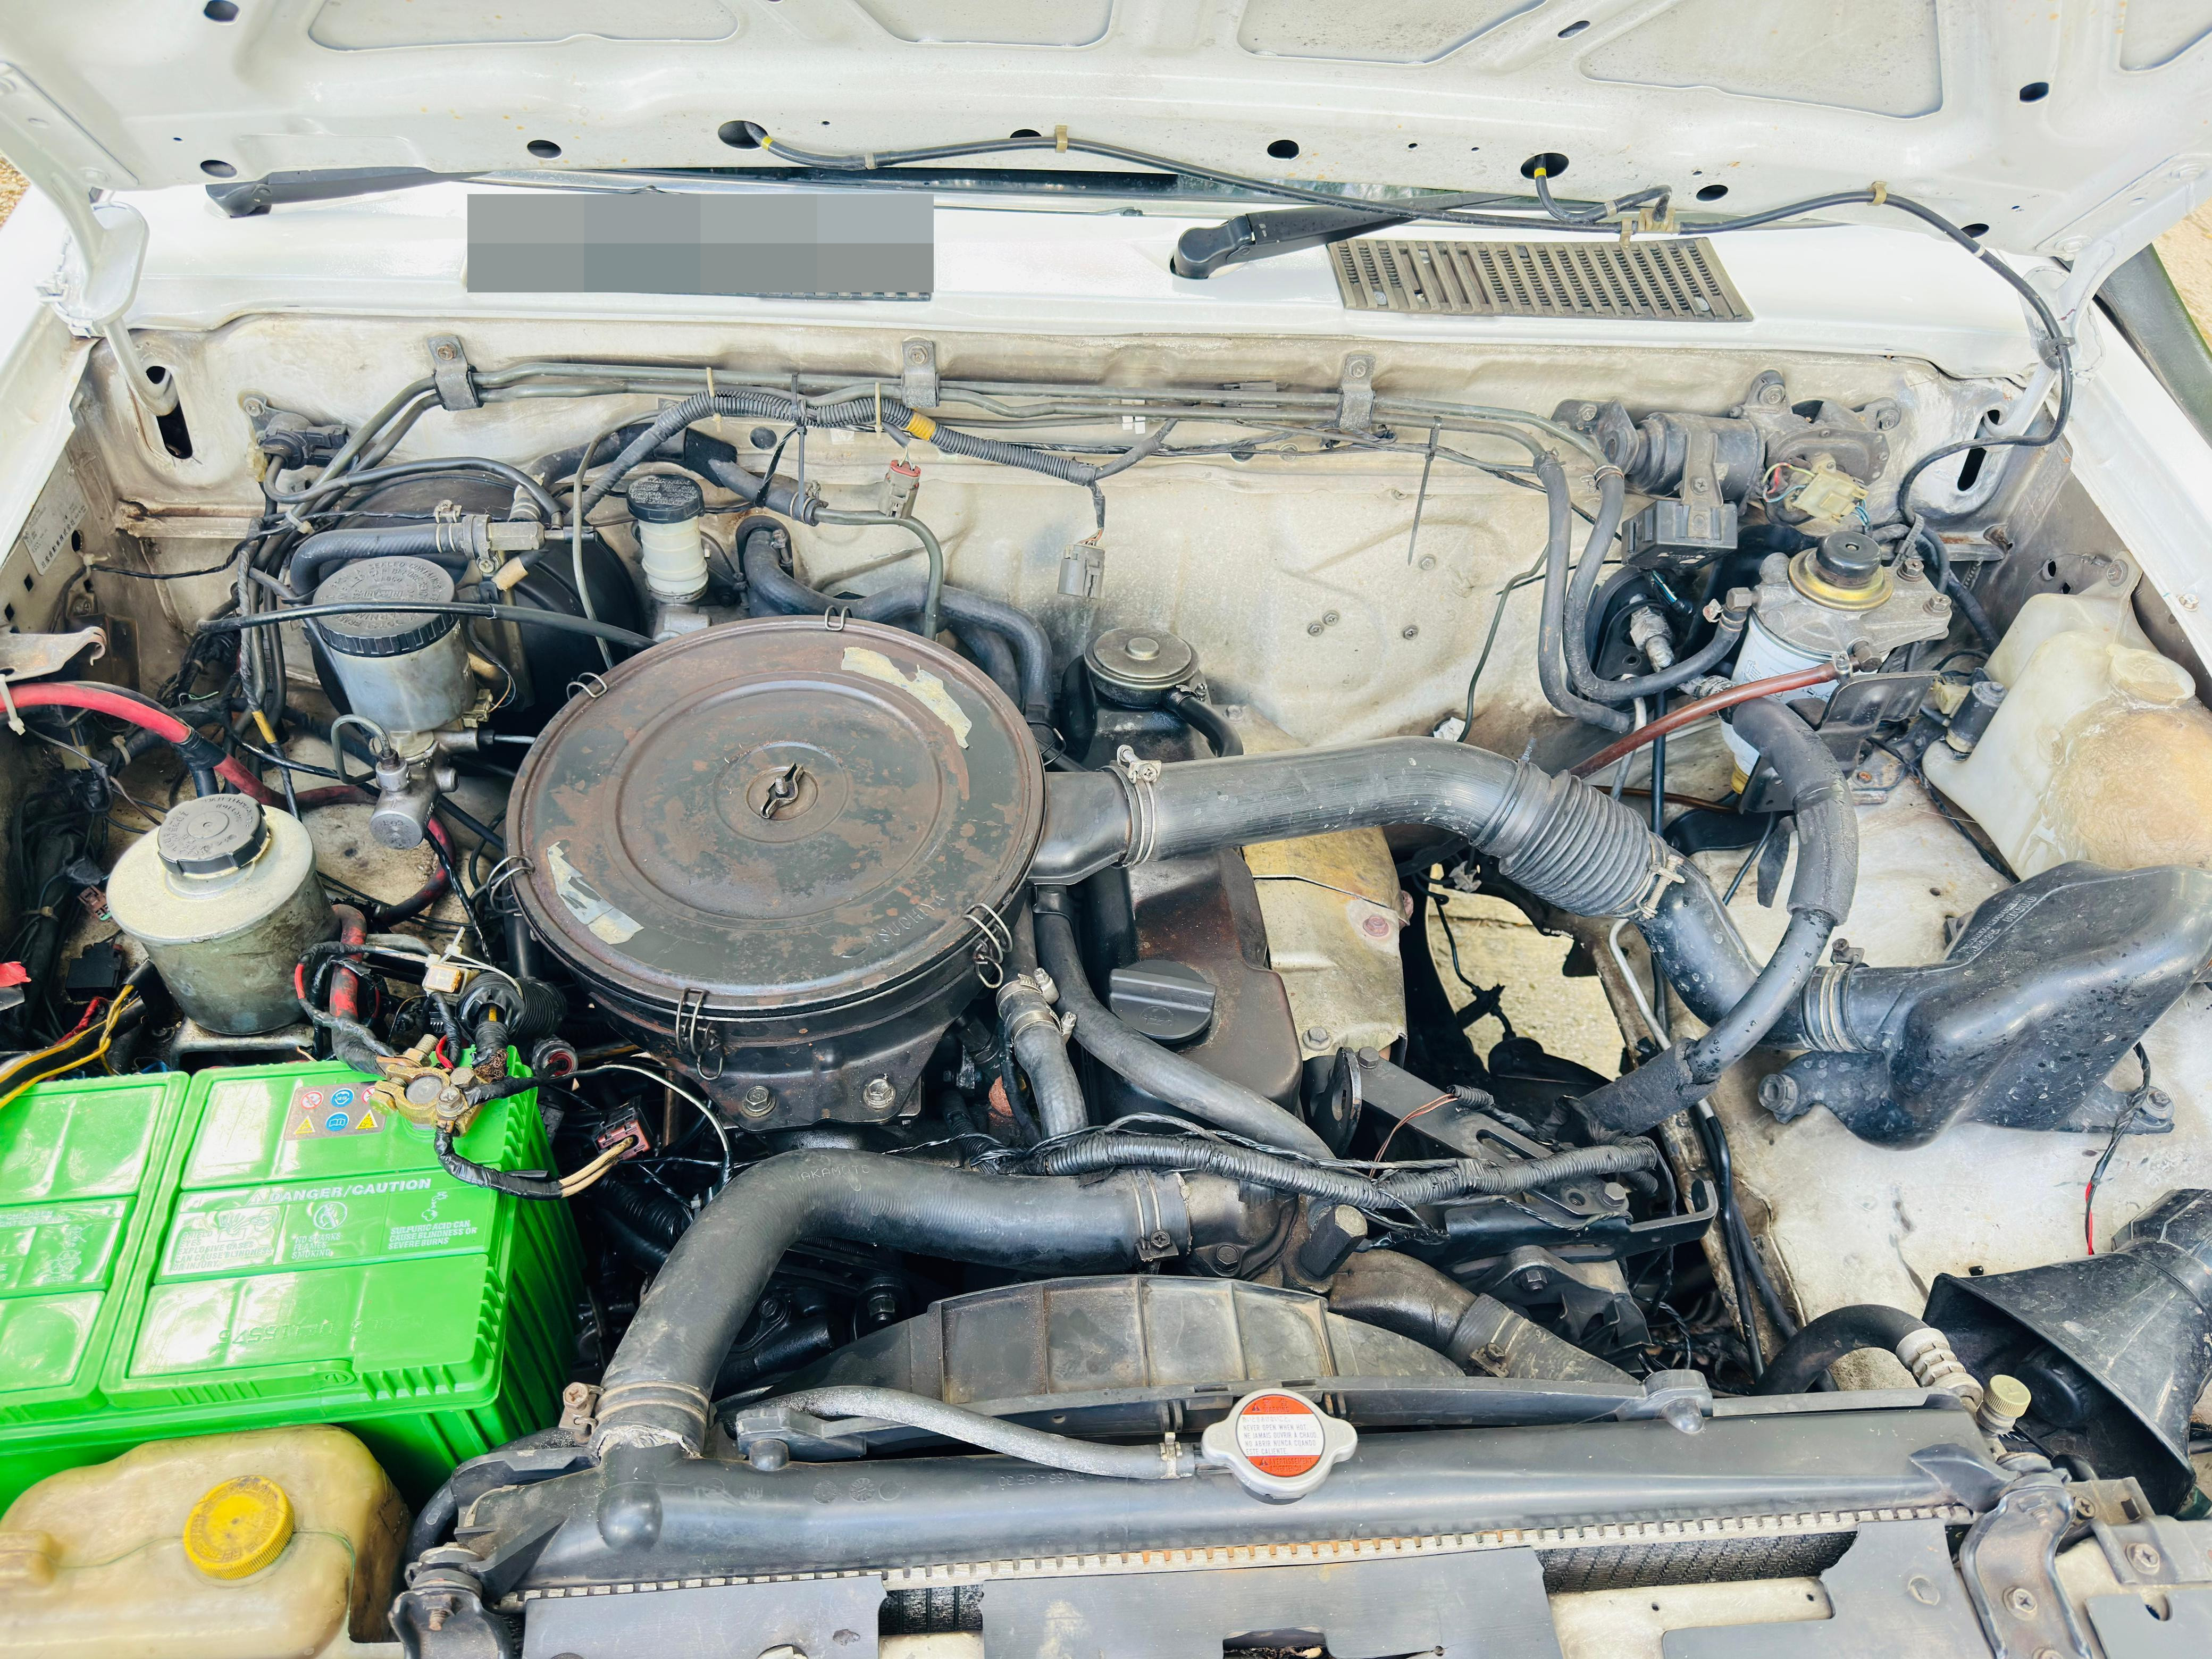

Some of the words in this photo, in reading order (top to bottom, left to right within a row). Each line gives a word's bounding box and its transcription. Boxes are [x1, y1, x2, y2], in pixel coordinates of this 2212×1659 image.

[390, 1225, 432, 1235] SULFURIC
[433, 1222, 452, 1231] ACID
[454, 1220, 471, 1228] CAN
[389, 1233, 417, 1243] CAUSE
[417, 1228, 464, 1239] BLINDNESS
[177, 1244, 225, 1255] EXPLOSIVE
[388, 1241, 420, 1250] SEVERE
[421, 1237, 449, 1247] BURNS
[195, 1252, 223, 1261] CAUSE
[224, 1247, 274, 1259] BLINDNESS
